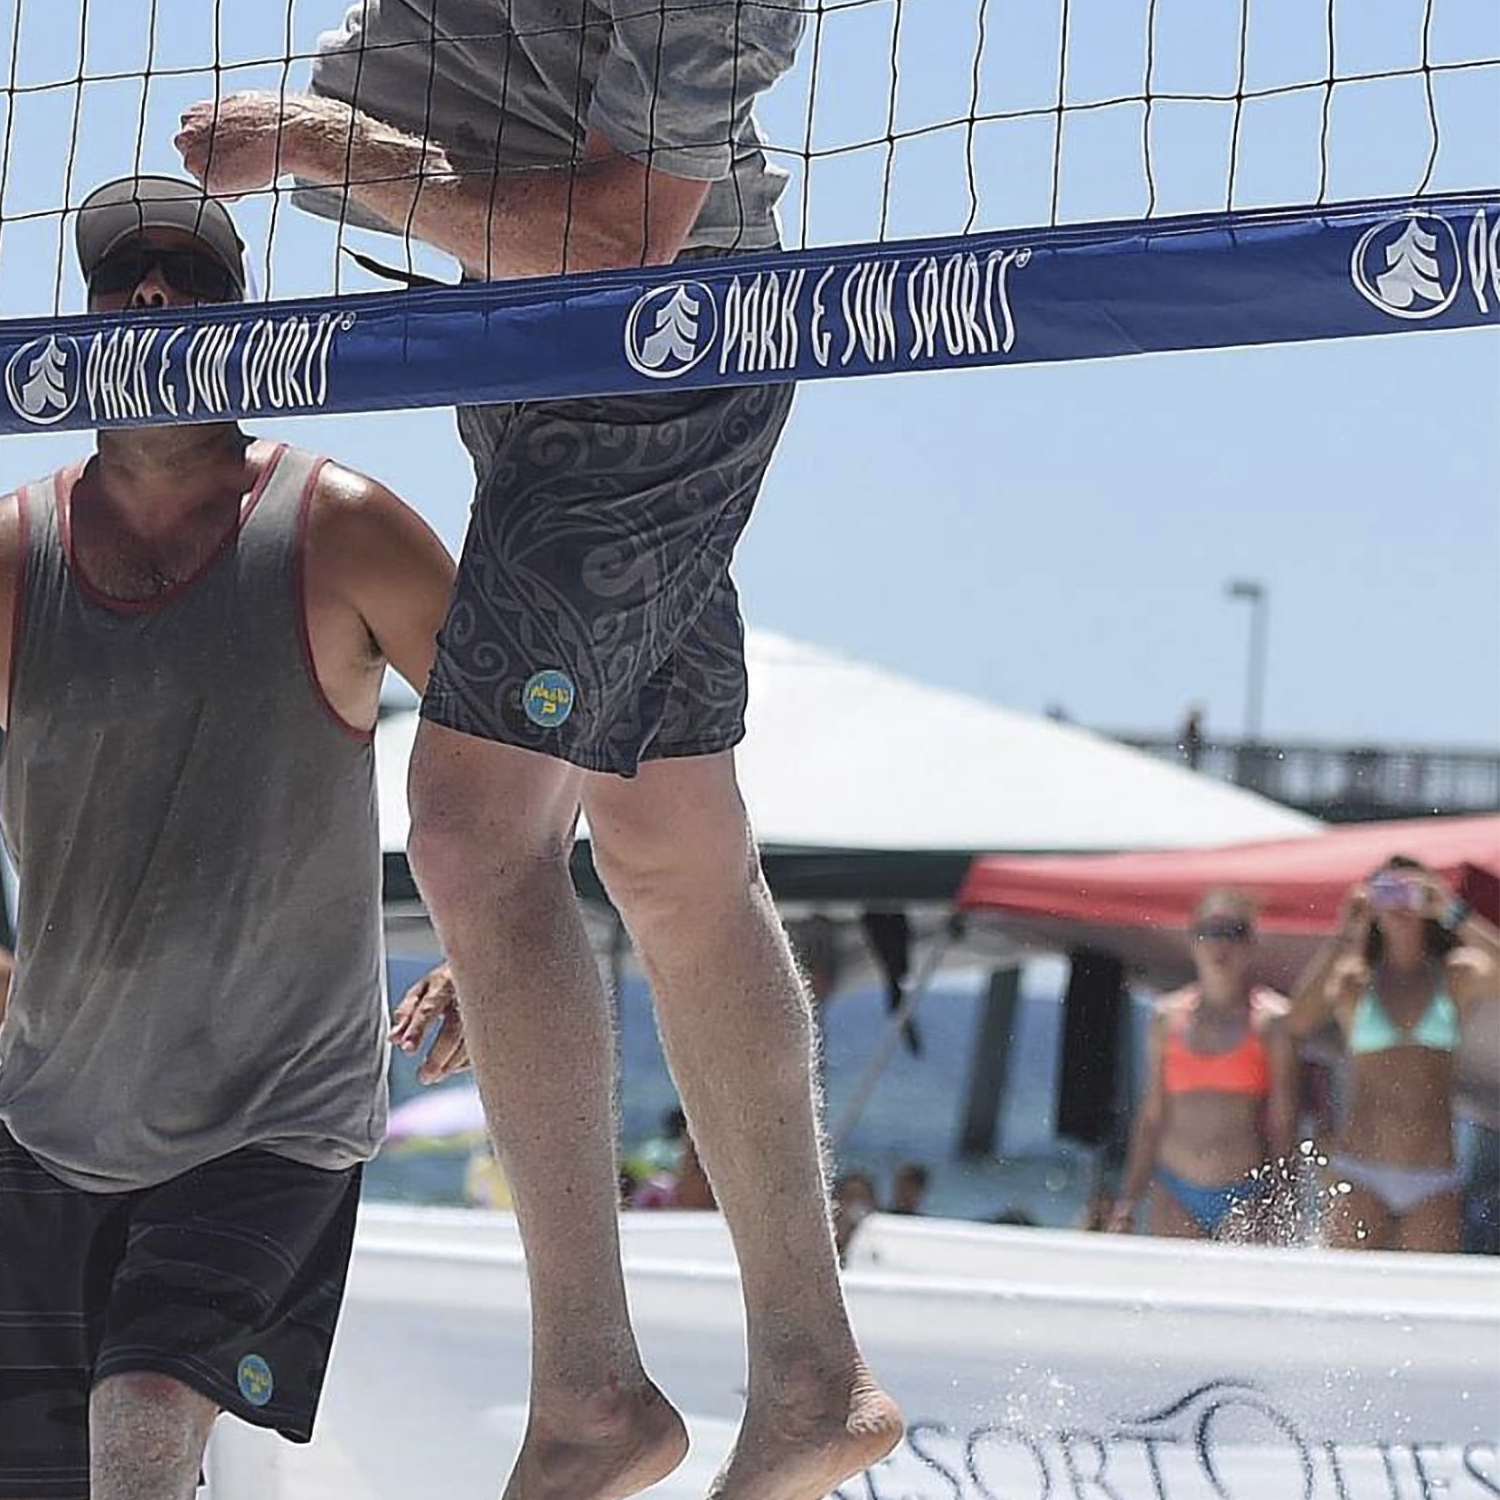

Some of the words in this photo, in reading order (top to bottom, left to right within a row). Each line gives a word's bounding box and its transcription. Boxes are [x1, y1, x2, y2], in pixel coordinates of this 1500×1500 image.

[718, 268, 806, 374] PARK
[841, 260, 900, 366] SUN
[908, 248, 1018, 360] SPORTS
[85, 327, 160, 420] PARK
[187, 322, 242, 415] SUN
